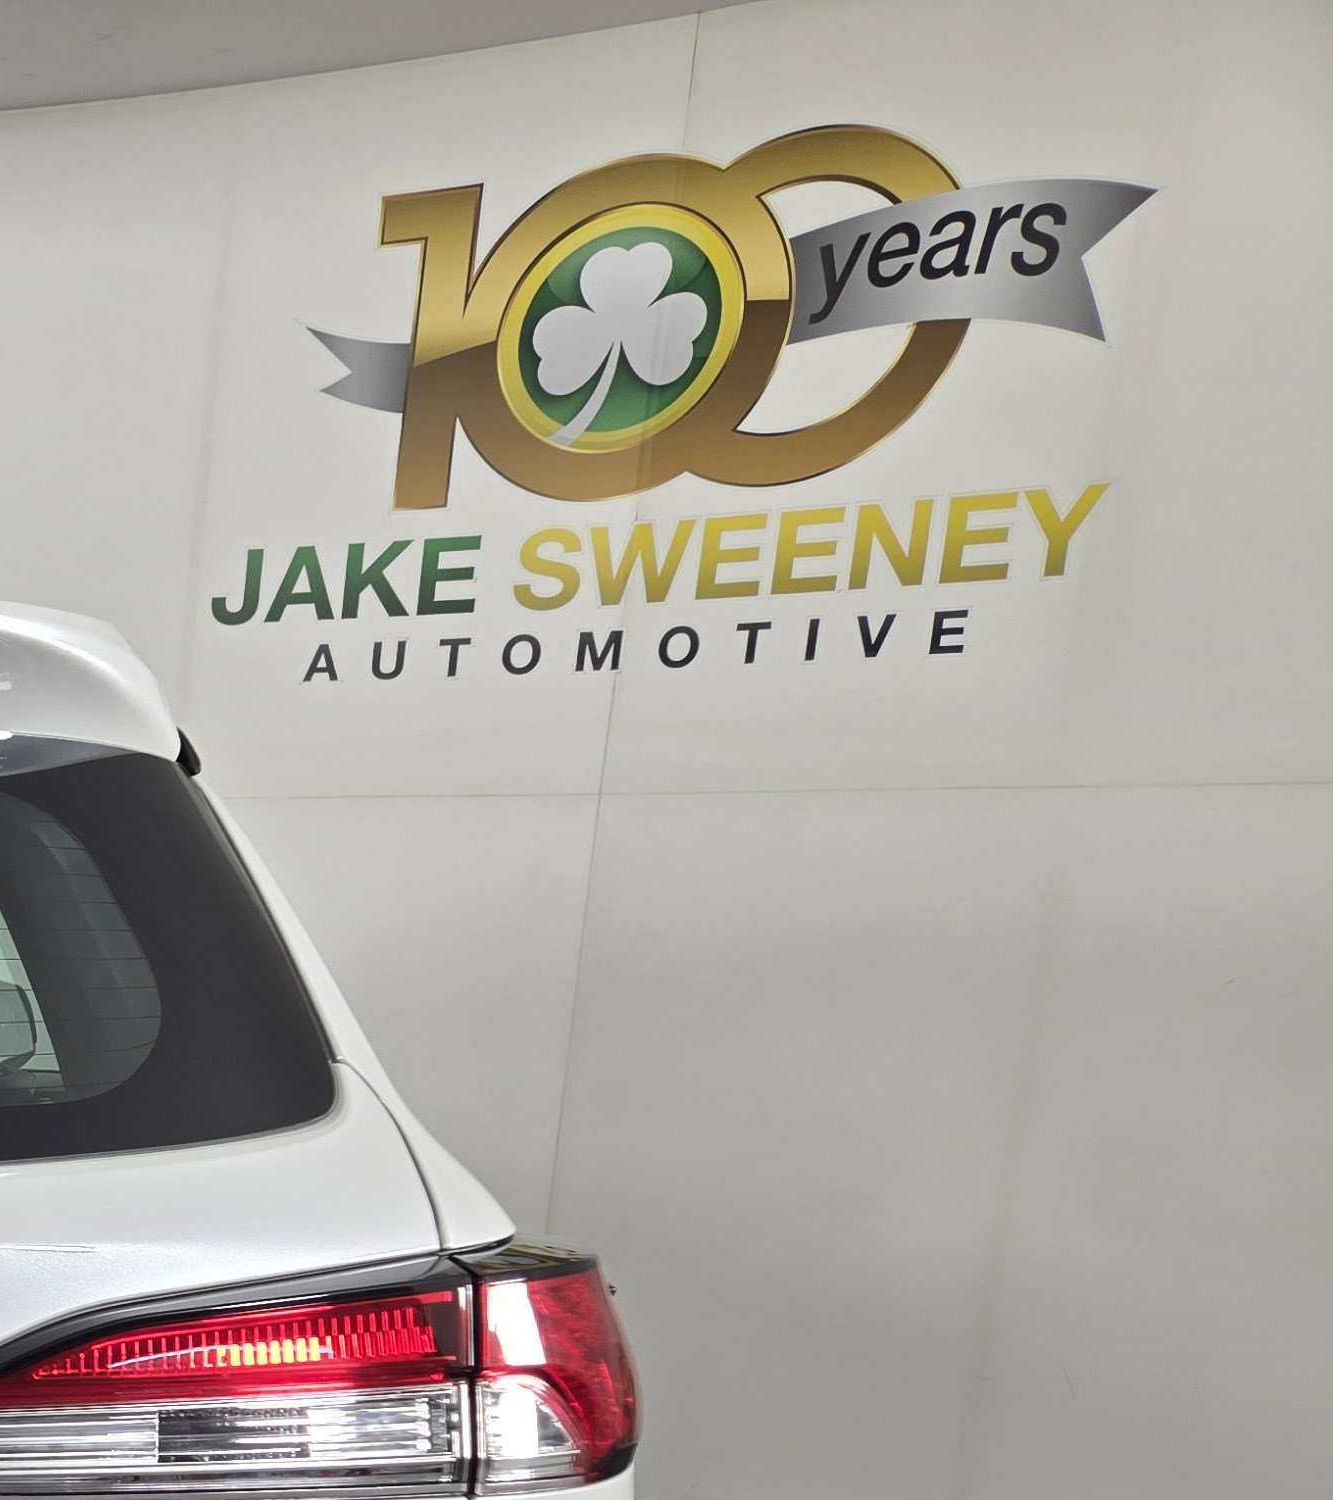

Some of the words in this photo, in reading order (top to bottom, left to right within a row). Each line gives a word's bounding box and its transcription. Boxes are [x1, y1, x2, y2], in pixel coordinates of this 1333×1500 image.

[807, 200, 1066, 325] years
[211, 534, 482, 627] JAKE
[513, 481, 1112, 611] SWEENEY
[302, 609, 970, 683] AUTOMOTIVE
